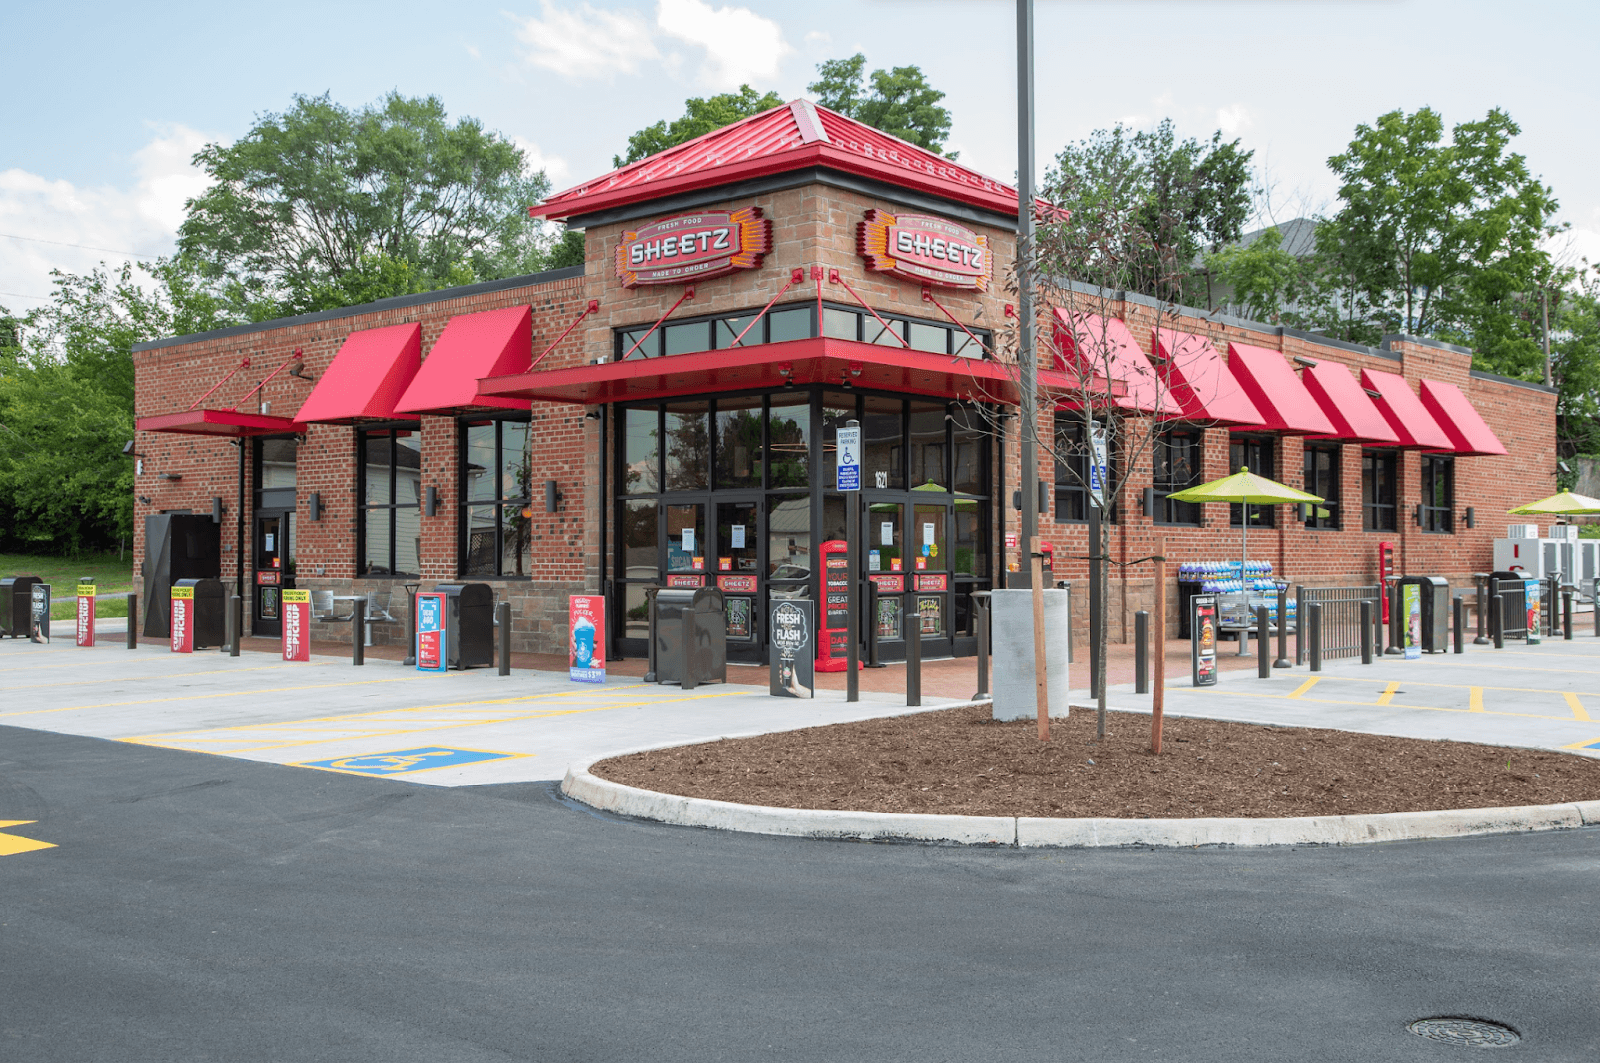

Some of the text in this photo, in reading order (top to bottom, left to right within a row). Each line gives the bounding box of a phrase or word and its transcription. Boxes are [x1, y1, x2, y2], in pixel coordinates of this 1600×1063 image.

[657, 217, 702, 231] FRESH FOOD
[921, 221, 960, 236] FRESH FOOD
[631, 228, 730, 265] SHEETZ
[897, 231, 982, 269] SHEETZ
[652, 270, 669, 278] MADE
[684, 263, 709, 273] ORDER
[914, 266, 932, 275] MADE
[945, 272, 965, 281] ORDER
[838, 431, 858, 439] RESERVED
[875, 471, 888, 489] 1621
[828, 573, 848, 581] YOUR
[827, 596, 848, 604] GREAT
[292, 604, 300, 645] PICKUP
[776, 613, 800, 625] FRESH
[776, 628, 800, 641] FLASH
